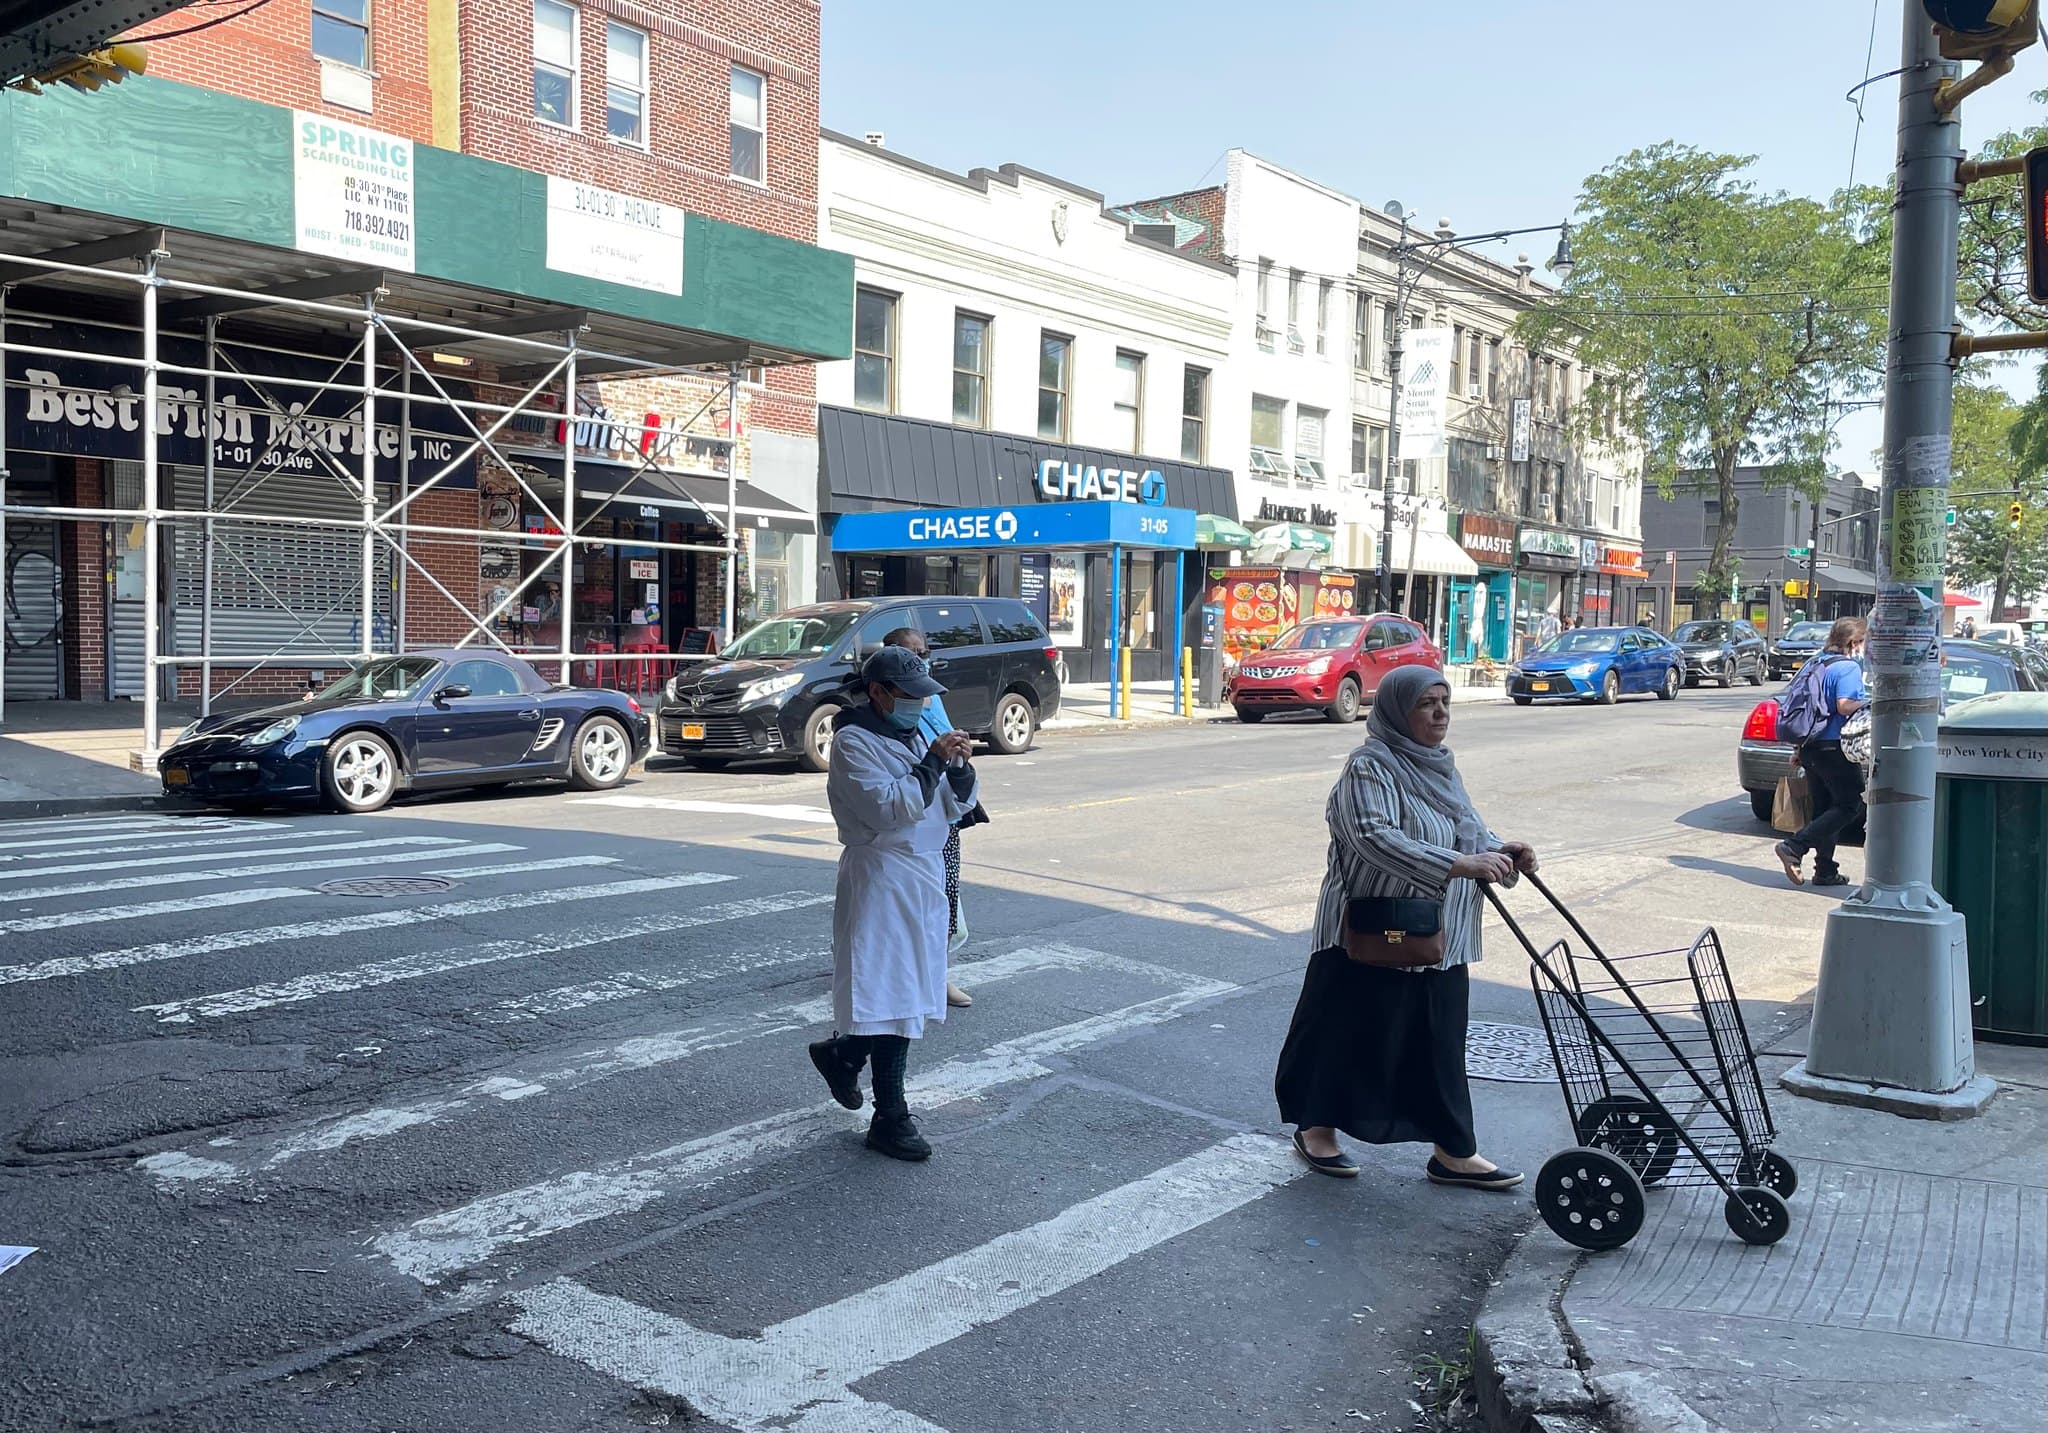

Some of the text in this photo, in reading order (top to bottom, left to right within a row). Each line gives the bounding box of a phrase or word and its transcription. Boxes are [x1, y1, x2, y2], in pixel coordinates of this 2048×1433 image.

[302, 121, 408, 167] SPRING
[302, 147, 409, 182] SCAFFOLDING LLC
[344, 188, 409, 215] LIC NY 11101
[575, 186, 602, 214] 31-01
[624, 199, 661, 229] AVENUE
[345, 209, 409, 242] 718.392.4921
[369, 240, 409, 257] SCAFFOLD
[1406, 387, 1436, 398] Mount
[1405, 399, 1430, 409] Sinai
[25, 368, 139, 432] Best
[156, 384, 254, 444] Fish
[423, 440, 452, 462] INC
[284, 452, 313, 470] Ave
[1039, 459, 1139, 504] CHASE
[1897, 489, 1921, 500] SAT
[640, 505, 660, 518] Coffee
[1899, 500, 1921, 511] SUN
[908, 515, 992, 540] CHASE
[1140, 517, 1169, 534] 31-05
[1464, 532, 1513, 555] NAMASTE
[637, 569, 652, 578] ICE
[1207, 614, 1214, 625] P
[1954, 745, 1976, 758] New
[1981, 747, 2012, 759] York
[2015, 748, 2044, 763] City
